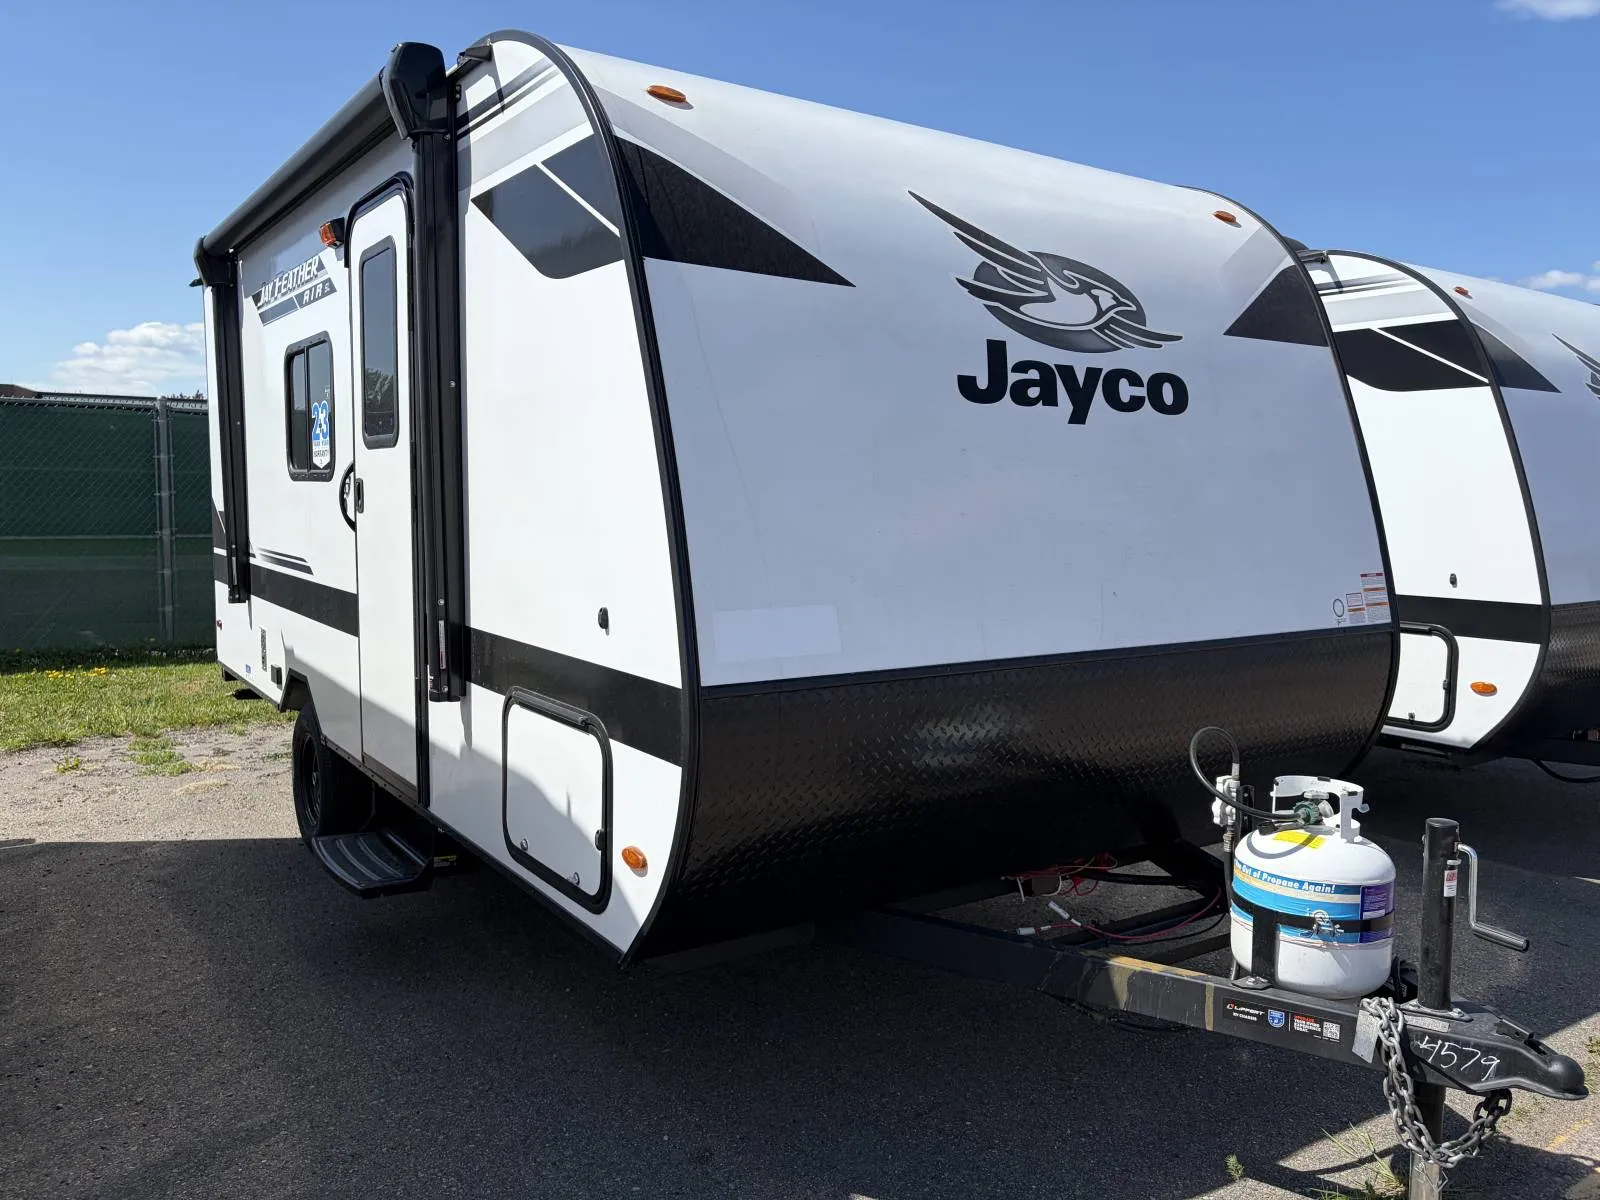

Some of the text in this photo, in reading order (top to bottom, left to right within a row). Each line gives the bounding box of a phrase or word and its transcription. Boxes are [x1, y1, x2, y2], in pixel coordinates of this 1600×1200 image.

[257, 255, 319, 307] JAY FEATHER
[302, 283, 323, 304] AIR
[957, 338, 1189, 425] Jayco
[1262, 873, 1299, 889] Propane
[1302, 881, 1336, 894] Again!
[1416, 1035, 1500, 1081] 4579
